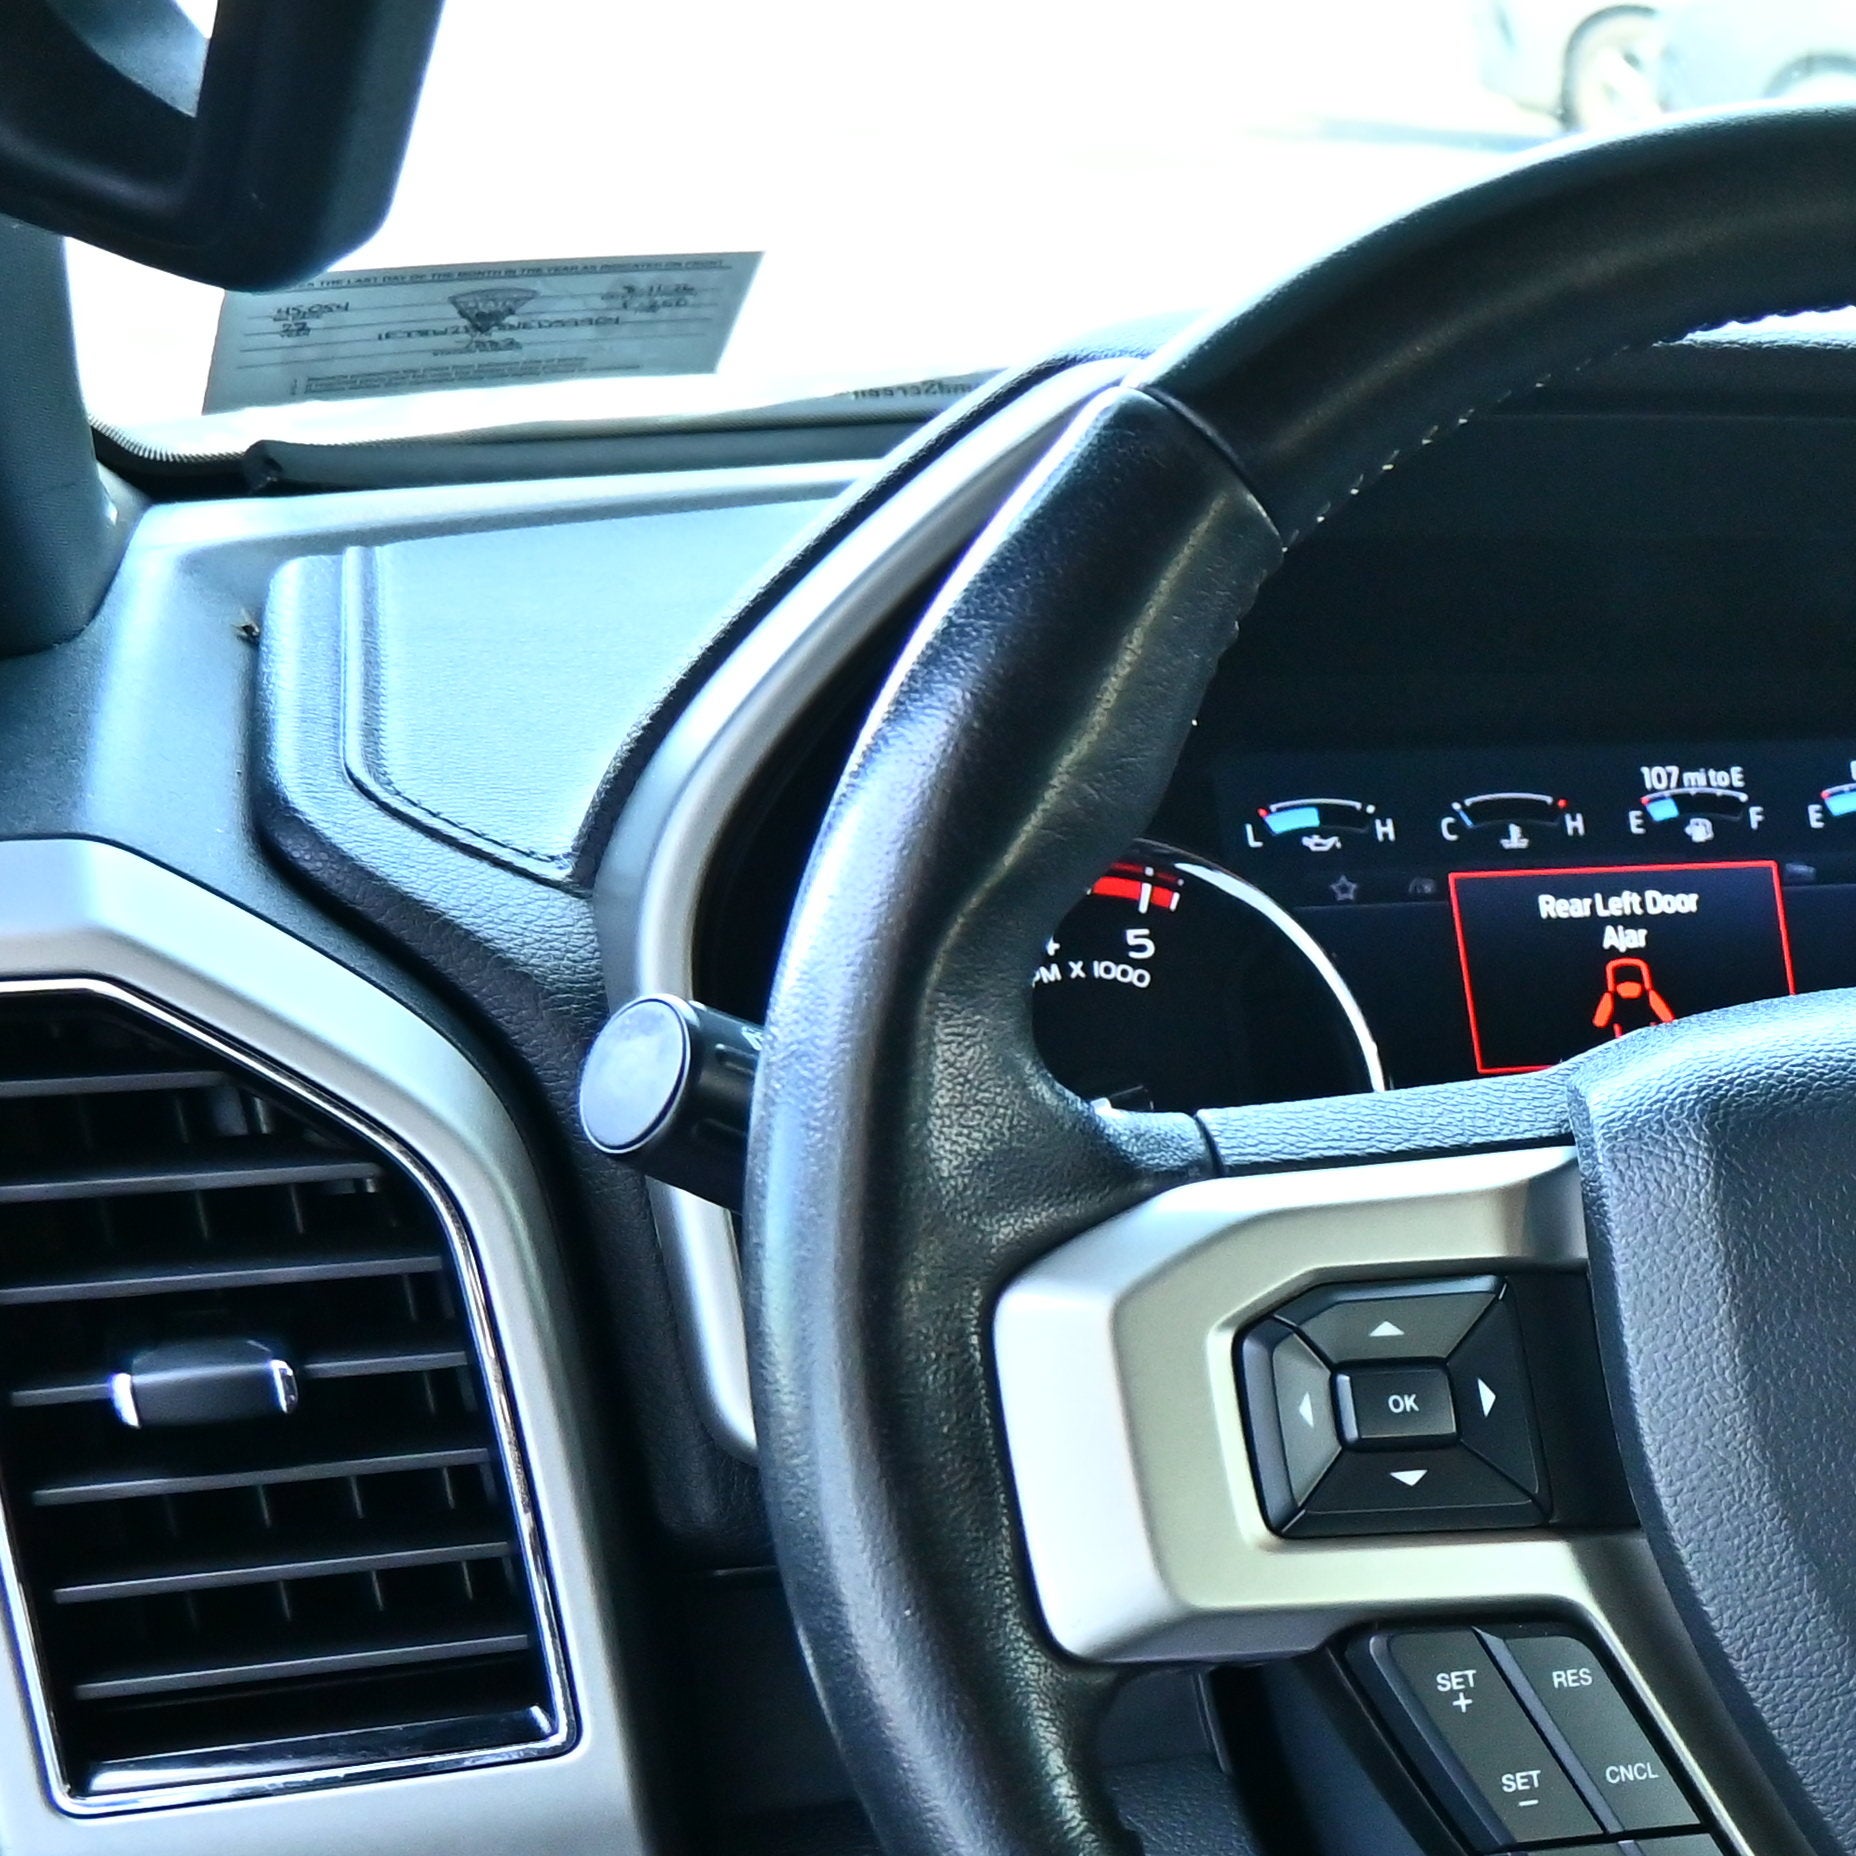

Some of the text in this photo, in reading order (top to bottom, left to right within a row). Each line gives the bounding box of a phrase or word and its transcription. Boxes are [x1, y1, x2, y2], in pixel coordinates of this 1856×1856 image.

[1640, 765, 1746, 791] 107 mi to E
[1564, 812, 1586, 837] H
[1628, 810, 1647, 835] E
[1749, 805, 1765, 831] F
[1807, 803, 1826, 829] E
[1245, 823, 1264, 848] L
[1375, 817, 1397, 842] H
[1440, 816, 1460, 842] C
[1537, 889, 1699, 920] Rear Left Door
[1124, 927, 1156, 960] 5
[1602, 924, 1648, 953] Ajar
[1092, 959, 1152, 989] 1000
[1387, 1393, 1420, 1414] OK
[1435, 1668, 1477, 1693] SET
[1551, 1667, 1593, 1689] RES
[1500, 1769, 1542, 1794] SET
[1605, 1762, 1660, 1785] CNCL
